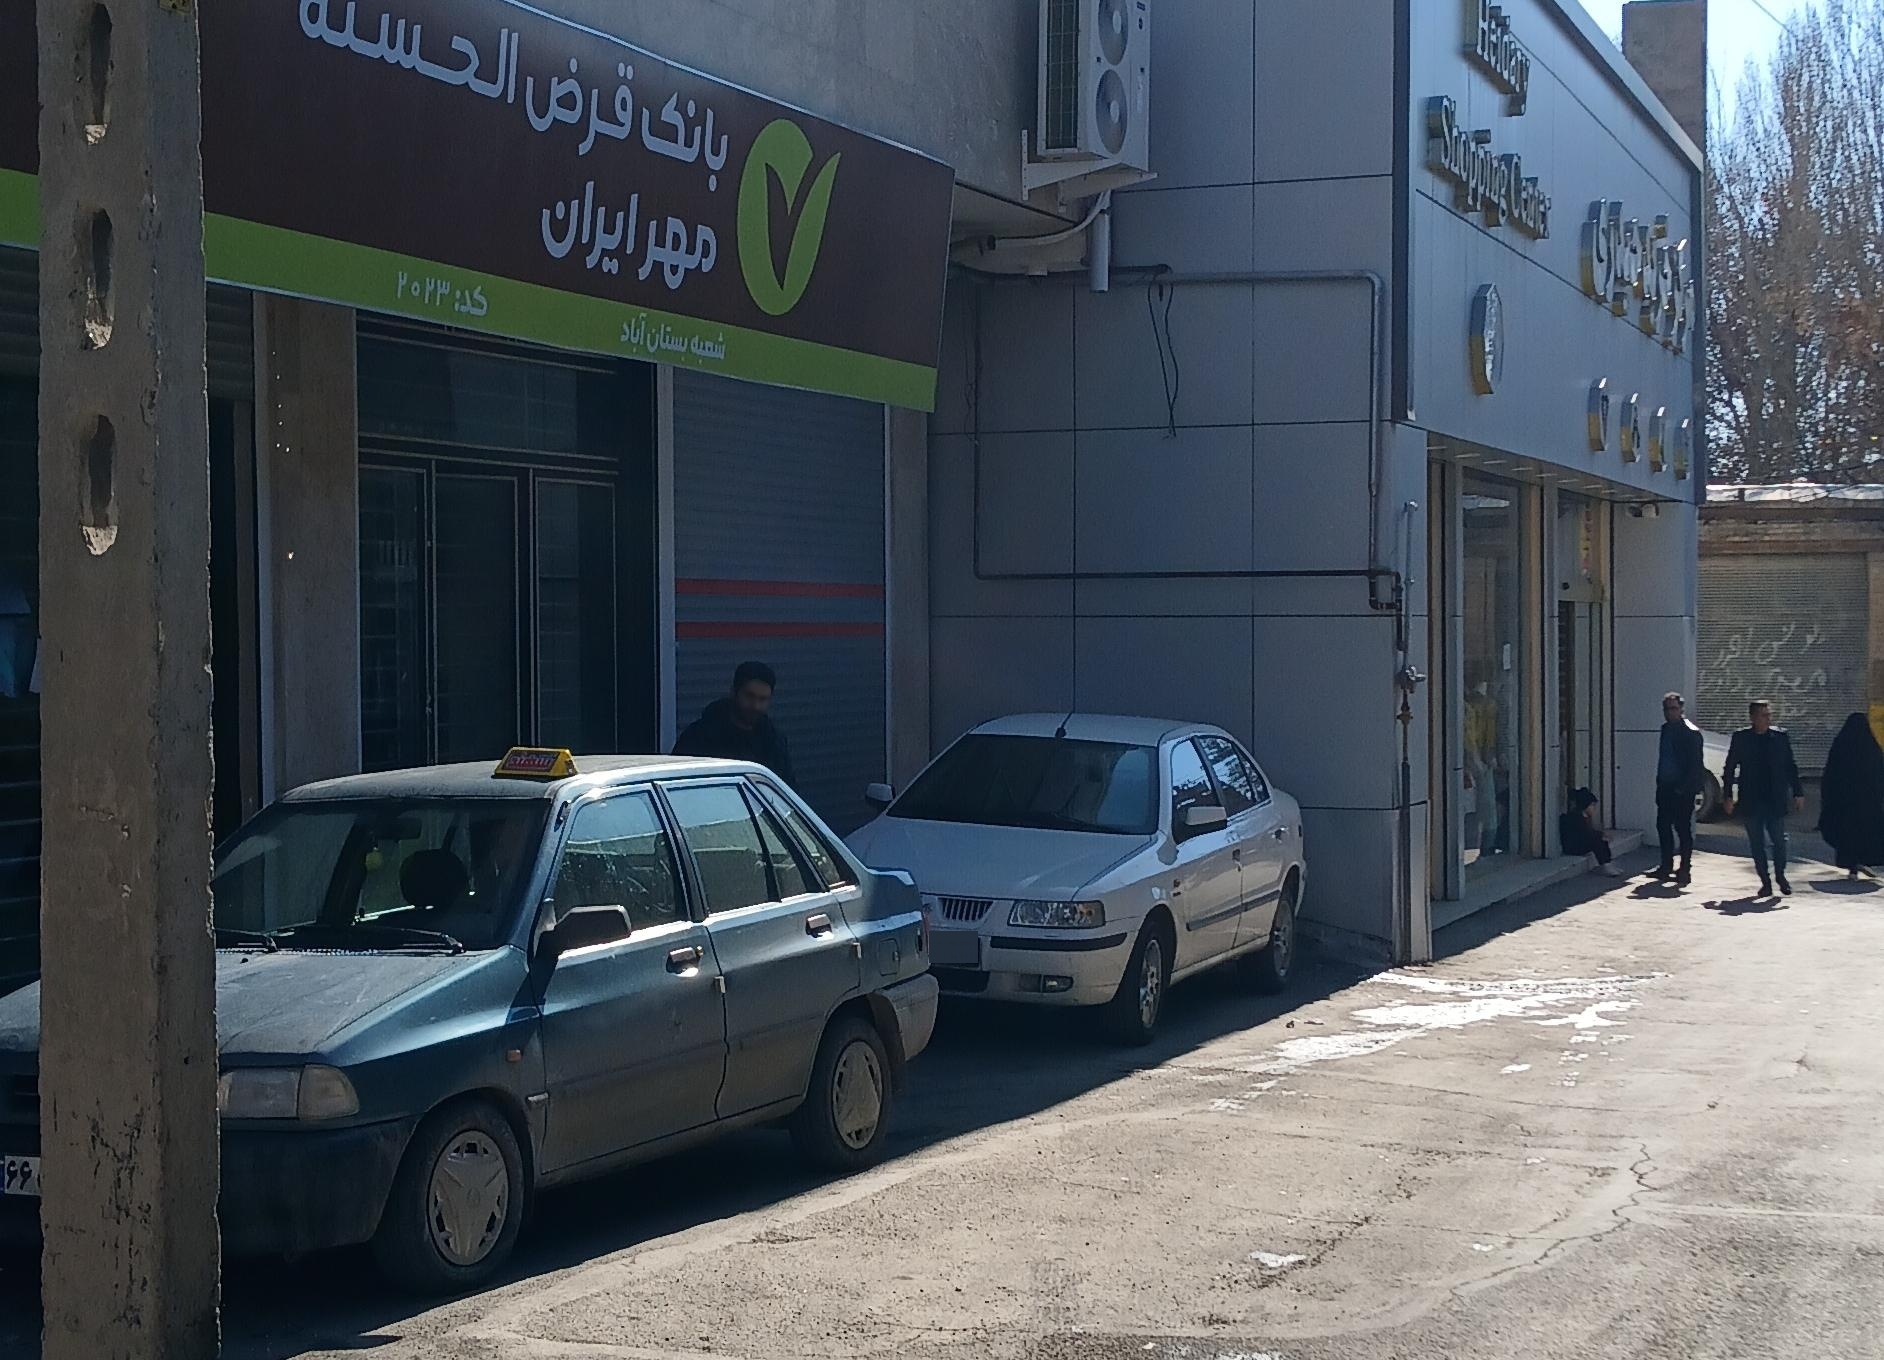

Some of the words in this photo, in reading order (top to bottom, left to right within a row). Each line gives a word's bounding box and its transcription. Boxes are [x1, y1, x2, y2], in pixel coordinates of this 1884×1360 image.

[525, 57, 633, 156] قرض
[641, 91, 729, 191] بانک
[1432, 95, 1509, 228] Shopping
[1508, 152, 1552, 240] Center
[542, 181, 638, 274] ایران
[638, 215, 718, 288] مهر
[397, 271, 450, 307] ۲۰۲۳
[454, 286, 488, 317] کد:
[620, 313, 648, 353] آباد
[648, 324, 687, 362] بستان
[690, 332, 725, 365] شعبه
